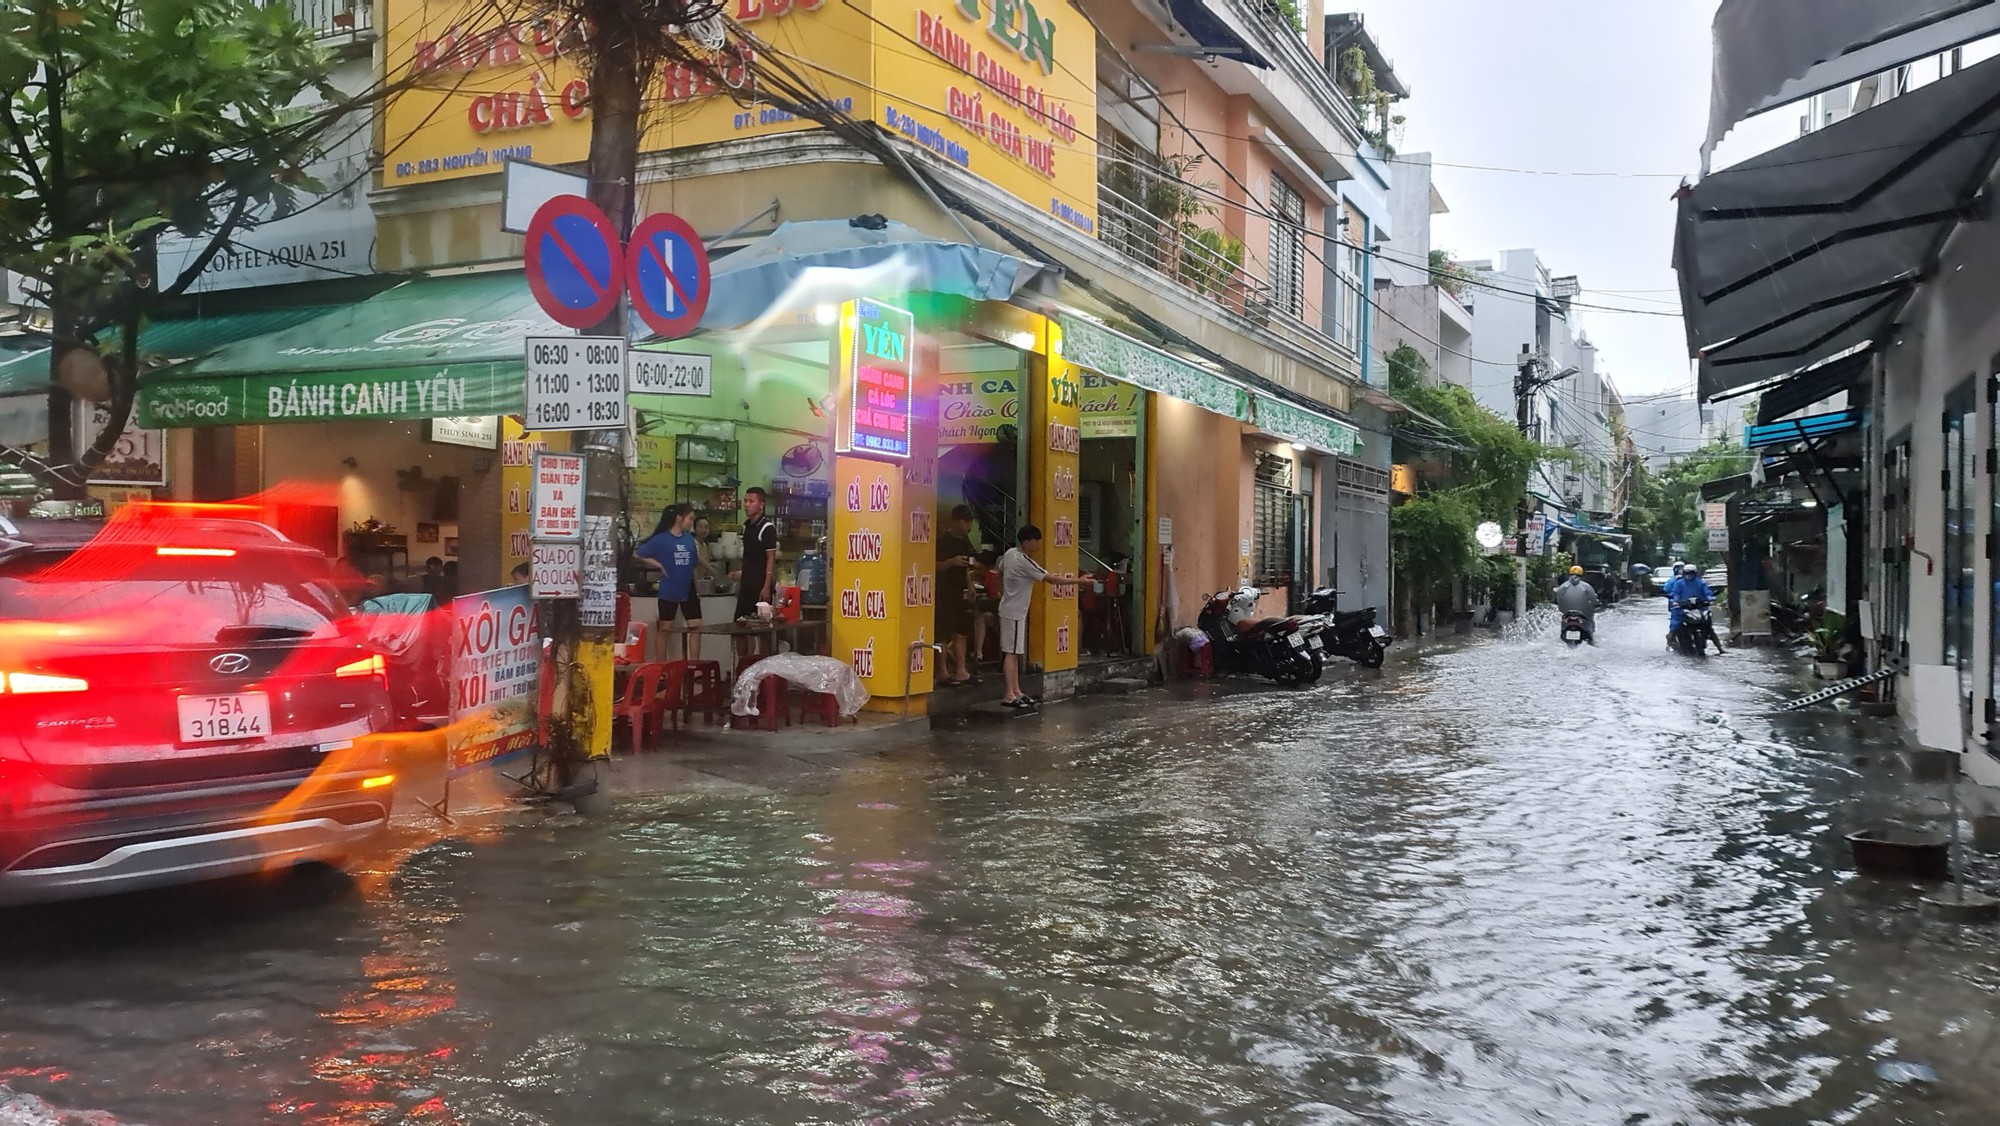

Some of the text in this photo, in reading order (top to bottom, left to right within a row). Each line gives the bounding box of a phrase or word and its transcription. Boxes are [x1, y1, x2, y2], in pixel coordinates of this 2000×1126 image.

[917, 9, 1076, 144] BÁNH CANH CÁ LÓC
[468, 71, 554, 134] CHẢ
[947, 86, 1056, 180] CHẢ CUA HUẾ
[266, 244, 316, 268] AQUA
[320, 240, 346, 259] 251
[534, 344, 568, 365] 06:30
[586, 345, 619, 365] 08:00
[864, 321, 905, 362] YẾN
[269, 368, 465, 417] BÁNH CANH YẾN
[535, 374, 569, 394] 11:00
[587, 373, 619, 393] 13:00
[1051, 368, 1078, 408] YẾN
[150, 396, 228, 418] GrabFood
[535, 402, 570, 423] 16:00
[587, 401, 620, 421] 18:30
[868, 389, 895, 408] CÁ LÓC
[944, 401, 996, 420] Chào
[462, 430, 480, 439] SINH
[503, 436, 523, 467] BÁNH
[541, 458, 557, 469] CHO
[847, 476, 889, 511] CÁ LÓC
[561, 504, 576, 518] GHẾ
[841, 579, 886, 619] CHẢ CUA
[457, 600, 501, 658] XÔI
[852, 638, 874, 677] HUẾ
[457, 671, 487, 710] XÔI
[206, 697, 243, 716] 75A
[191, 717, 261, 738] 318.44
